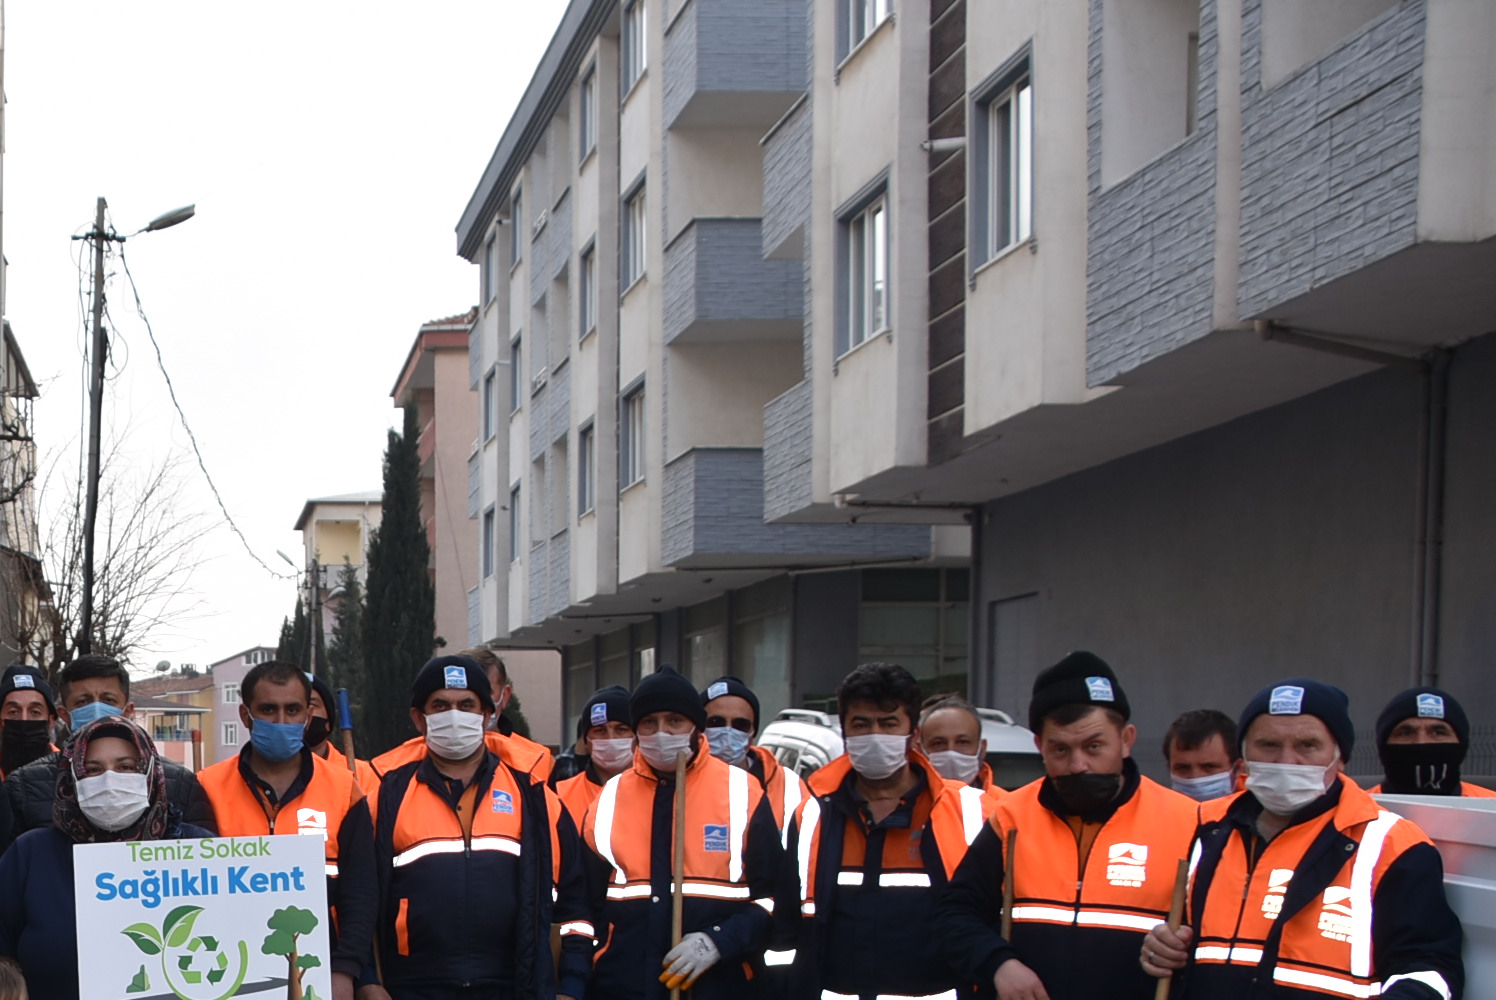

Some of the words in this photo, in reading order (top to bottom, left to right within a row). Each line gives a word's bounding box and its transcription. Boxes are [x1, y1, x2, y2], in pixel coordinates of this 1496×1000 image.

[126, 840, 194, 862] Temiz
[199, 837, 271, 860] Sokak
[95, 867, 219, 908] Sağlıklı
[228, 865, 306, 894] Kent
